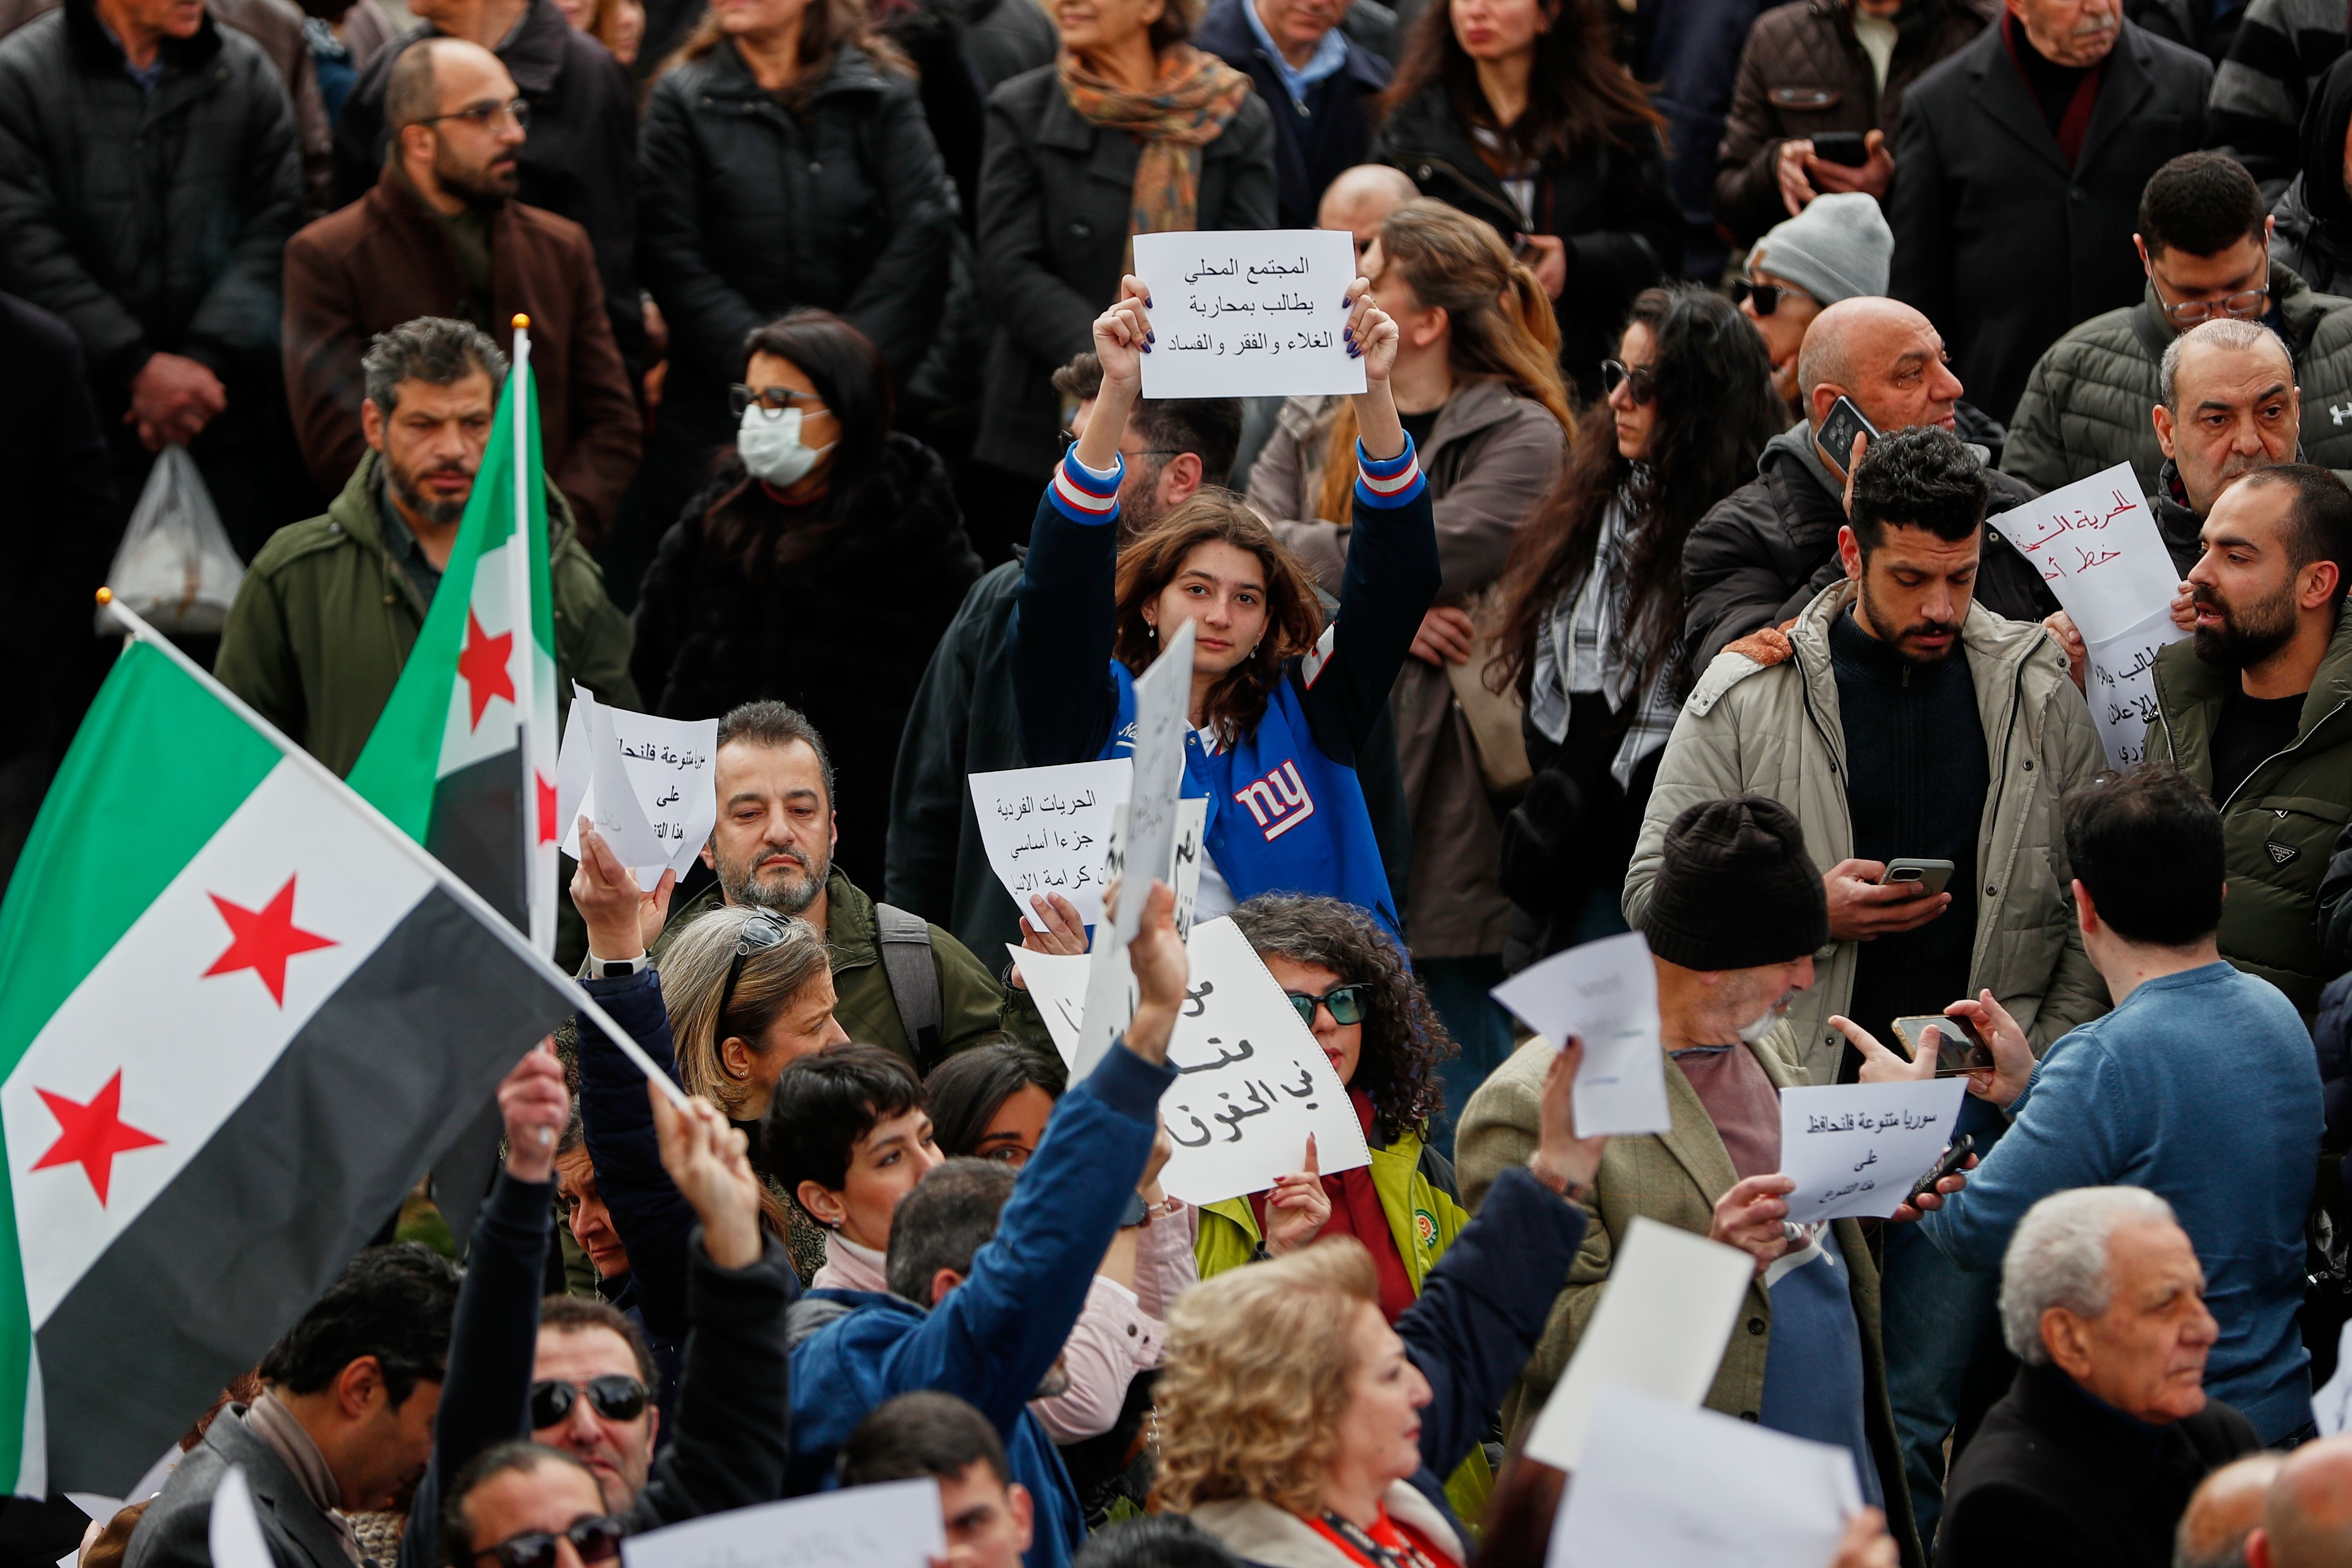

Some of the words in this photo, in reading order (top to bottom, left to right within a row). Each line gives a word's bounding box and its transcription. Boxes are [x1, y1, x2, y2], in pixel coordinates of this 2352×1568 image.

[1185, 258, 1238, 285] المحلي
[1247, 257, 1308, 284] المجتمع
[1190, 294, 1255, 318] بمحاربة
[1263, 292, 1314, 316] يطالب
[1287, 331, 1332, 351] الغلاء
[2074, 489, 2137, 529] الحرية
[2076, 544, 2120, 573] خط
[616, 738, 655, 761] فلنحا
[661, 746, 693, 770] متنوعة
[656, 785, 679, 807] على
[997, 795, 1033, 821] الفردية
[1040, 789, 1096, 815] الحريات
[671, 823, 683, 839] هذا
[1054, 830, 1093, 851] جزءا
[1011, 828, 1048, 861] أساسي
[1043, 865, 1090, 889] كرامة
[1280, 1061, 1318, 1110] في
[1166, 1080, 1279, 1147] الحقوق
[1807, 1114, 1854, 1133] فلنحافظ
[1858, 1112, 1899, 1133] متنوعة
[1904, 1109, 1937, 1130] سوريا
[1855, 1149, 1878, 1172] على
